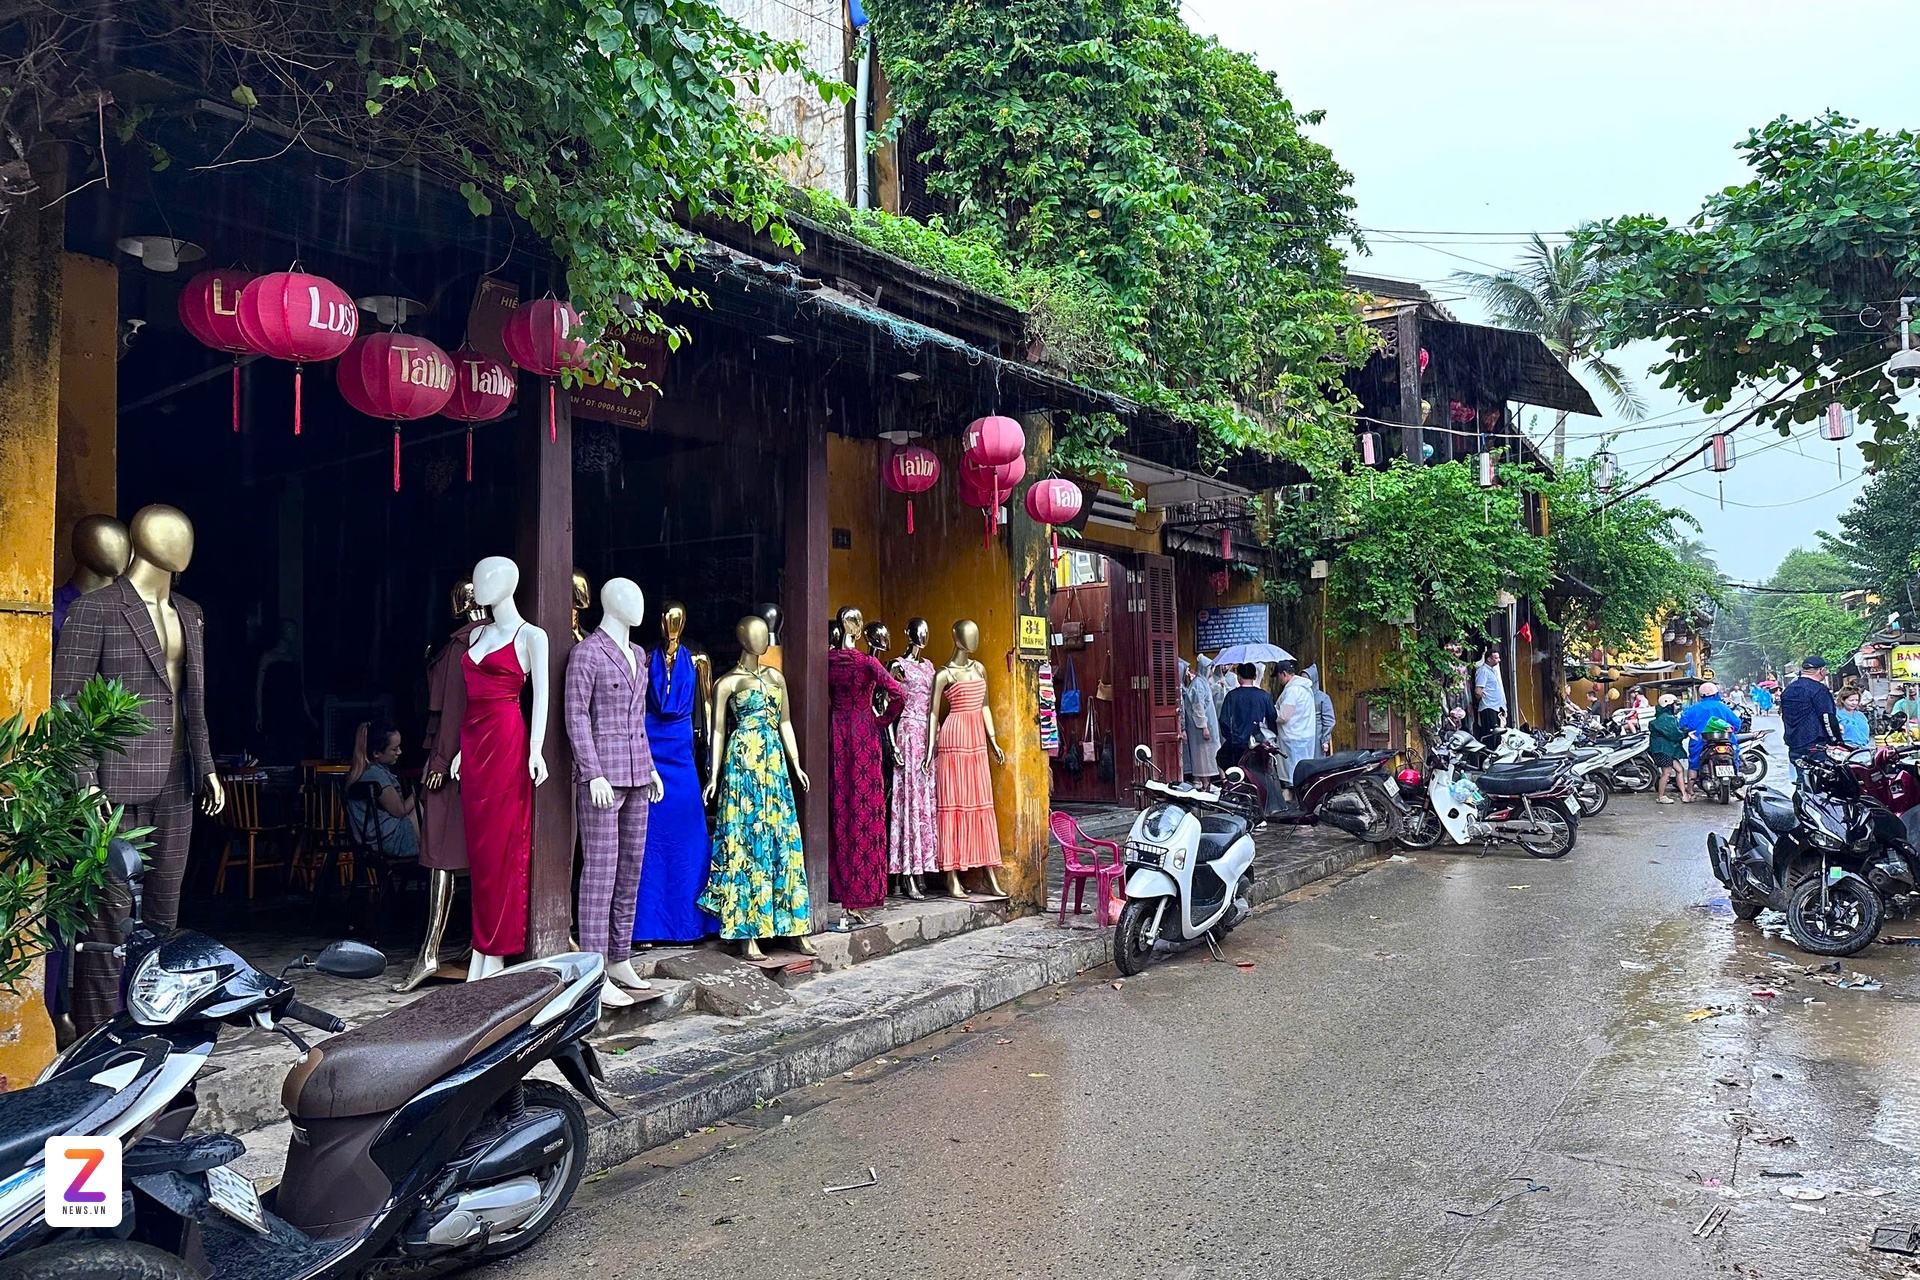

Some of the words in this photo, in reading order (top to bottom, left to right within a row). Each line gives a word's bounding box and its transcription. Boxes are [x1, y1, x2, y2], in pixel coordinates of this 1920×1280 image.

[309, 286, 356, 337] Lusi
[631, 332, 655, 345] SHOP
[597, 401, 615, 411] 0906
[616, 405, 627, 414] 515
[628, 408, 641, 417] 262
[895, 453, 936, 476] Tailor
[1026, 620, 1040, 635] 34
